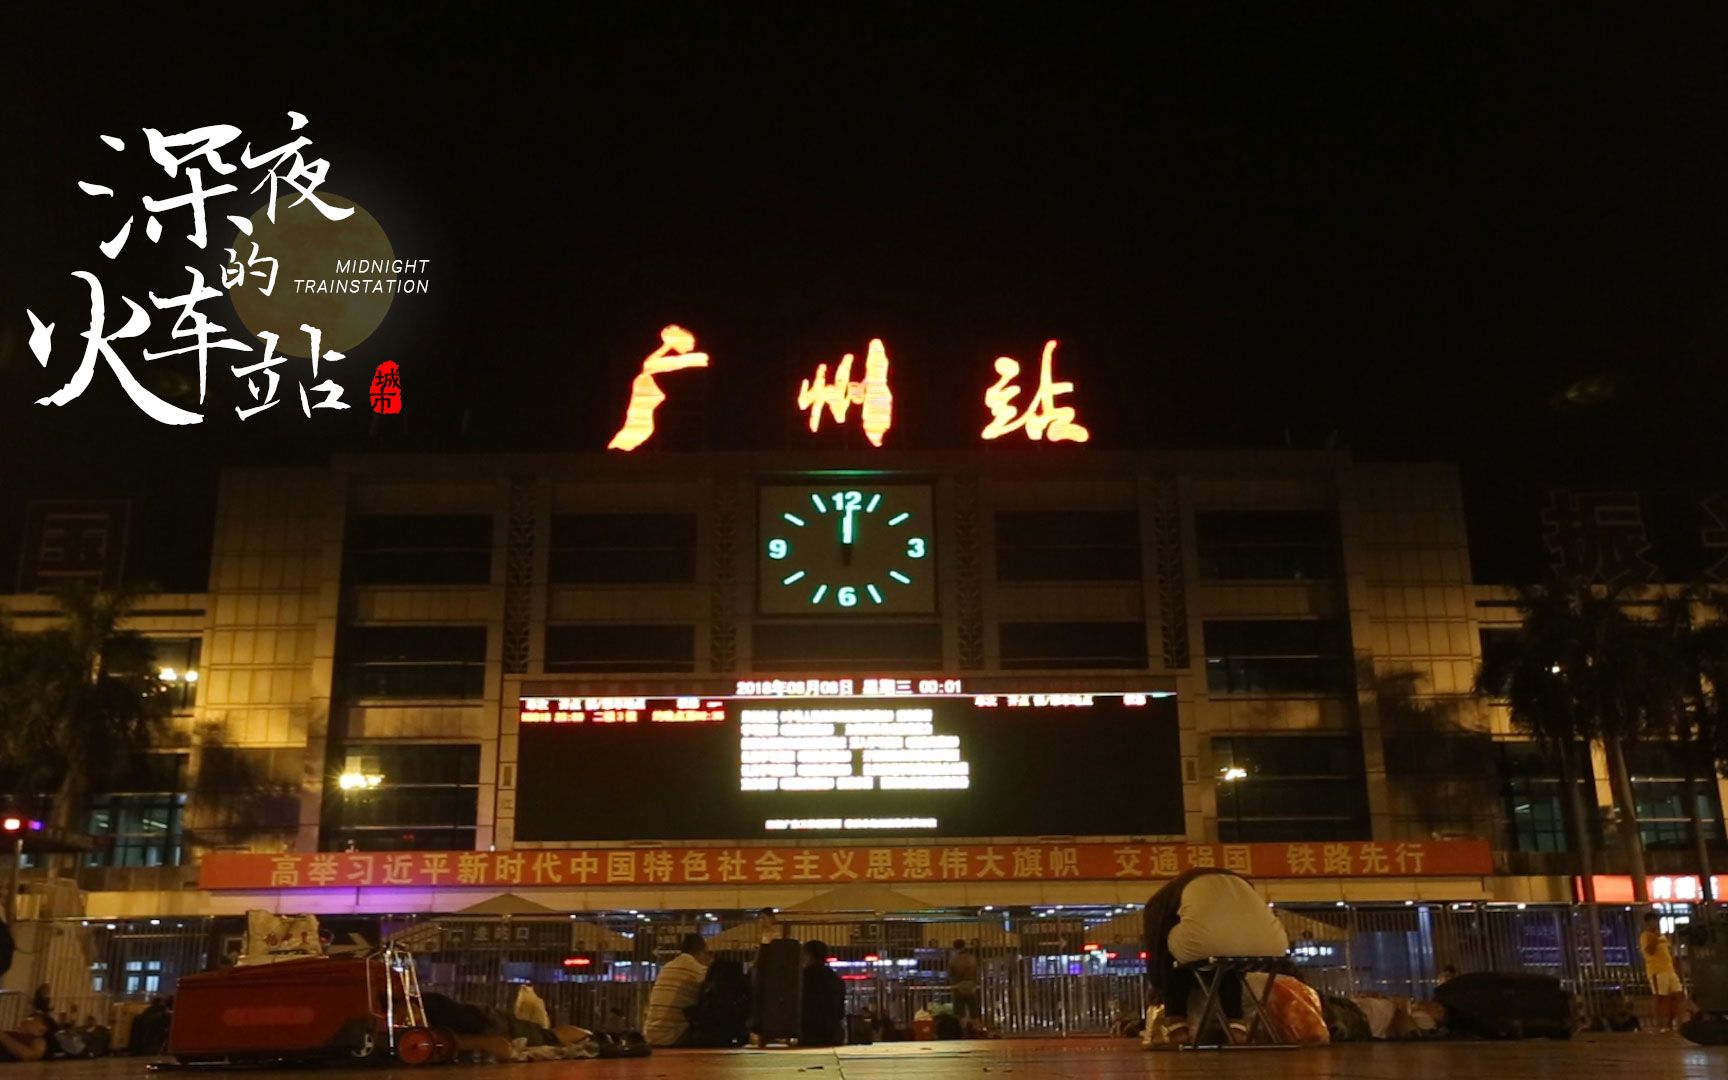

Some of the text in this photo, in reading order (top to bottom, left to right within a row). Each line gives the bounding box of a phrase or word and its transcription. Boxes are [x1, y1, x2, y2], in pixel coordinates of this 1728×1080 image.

[608, 325, 1089, 451] 广州站
[832, 490, 862, 511] 12
[768, 537, 926, 560] 9 3
[837, 586, 857, 607] 6
[271, 847, 1080, 887] 高举习近平新时代中国特色社会主义思想伟大旗帜
[1286, 842, 1425, 874] 铁路先行
